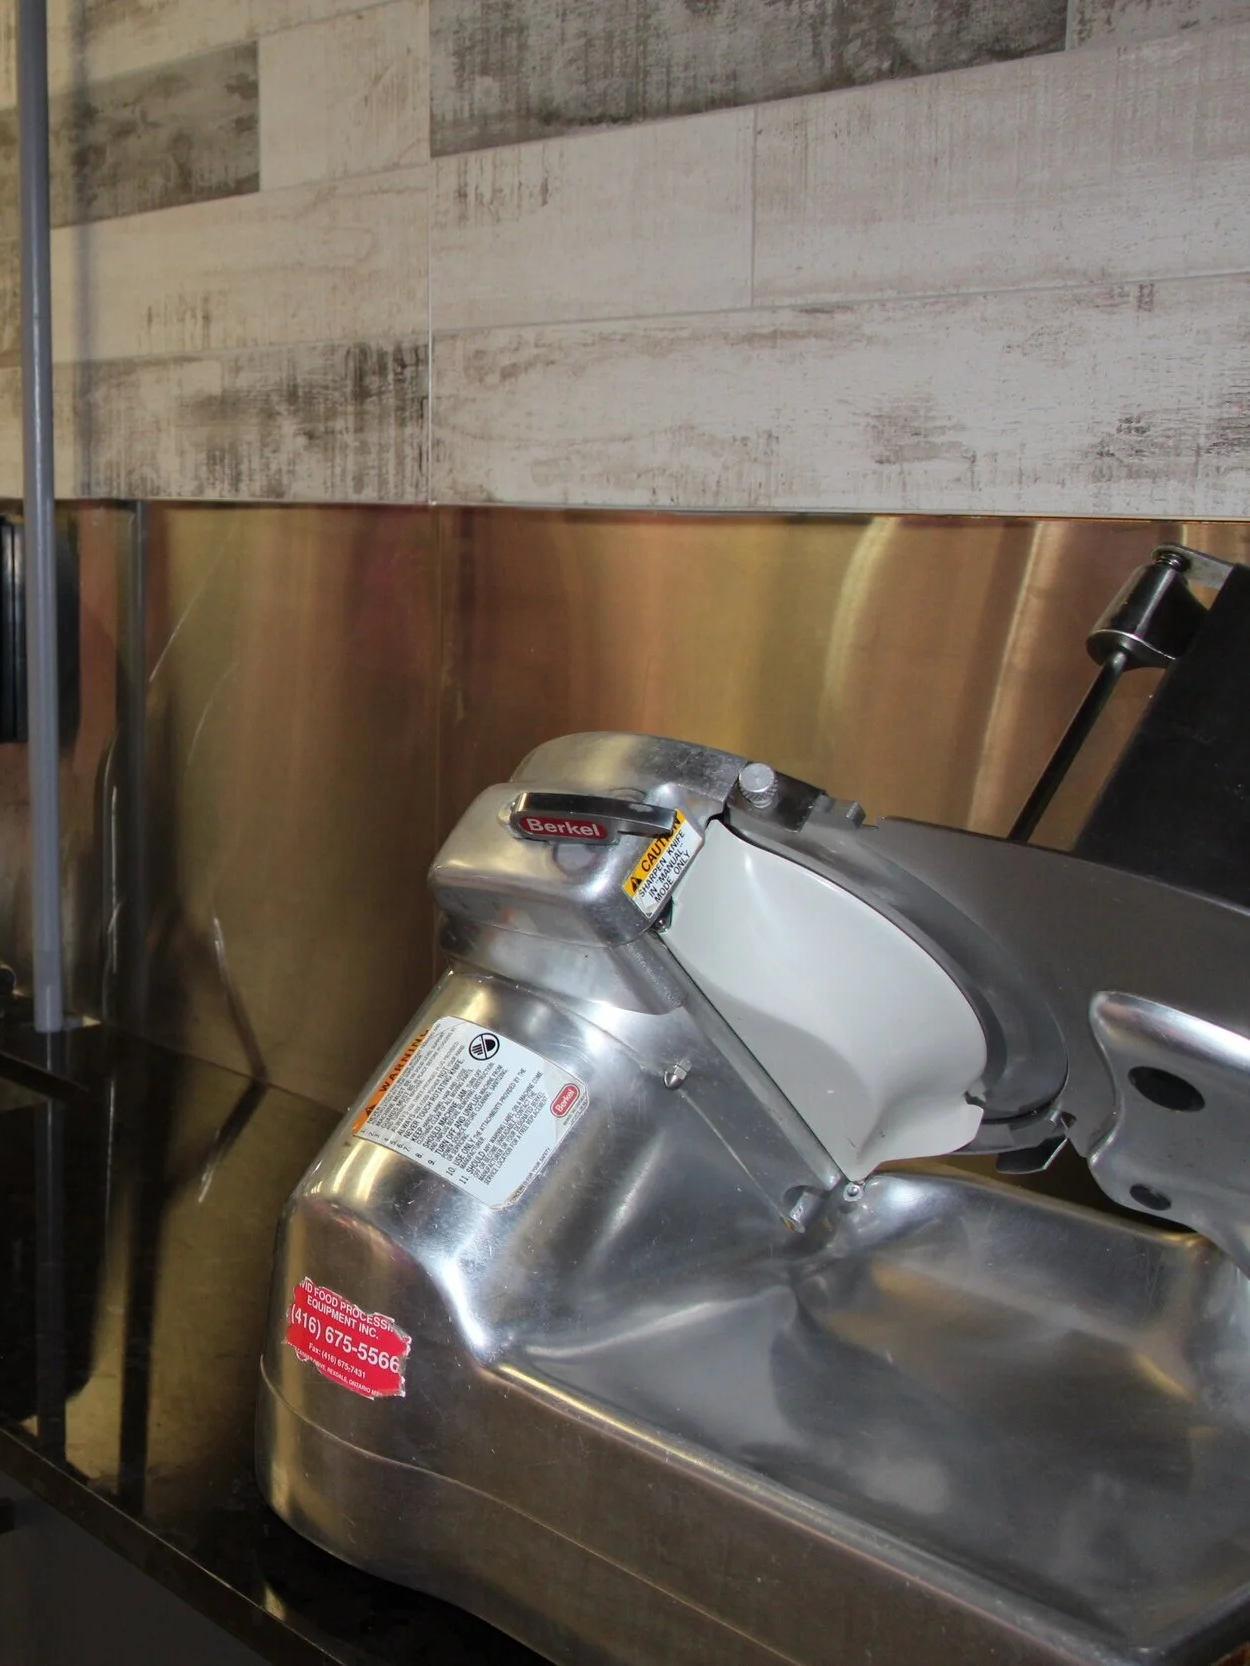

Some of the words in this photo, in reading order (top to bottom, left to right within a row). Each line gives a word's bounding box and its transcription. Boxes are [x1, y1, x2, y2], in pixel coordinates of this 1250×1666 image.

[525, 817, 601, 839] Berkel
[639, 815, 681, 873] CAUTN
[637, 856, 666, 898] SHARPEN
[665, 829, 685, 856] KNIFE
[653, 875, 673, 903] MODE
[672, 849, 691, 875] ONLY
[648, 885, 657, 897] IN
[511, 1075, 521, 1083] BY
[516, 1067, 527, 1076] THE
[395, 1112, 416, 1135] ALWAYS
[436, 1066, 449, 1079] NOT
[443, 1096, 453, 1105] ALL
[448, 1081, 464, 1098] MOVING
[497, 1081, 517, 1103] PROVIDED
[526, 1090, 537, 1100] THE
[554, 1088, 575, 1112] Berkel
[374, 1102, 395, 1126] MACHINE
[392, 1087, 405, 1102] MUST
[402, 1078, 411, 1087] BE
[379, 1106, 399, 1128] GUARDS
[395, 1091, 410, 1107] MUST
[406, 1082, 416, 1091] BE
[402, 1119, 420, 1139] NEVER
[415, 1100, 434, 1120] TOUCH
[428, 1074, 452, 1102] ROTATING
[409, 1125, 425, 1142] KEEP
[447, 1080, 457, 1090] AND
[453, 1067, 467, 1081] LOOSE
[420, 1125, 442, 1148] SHOULD
[436, 1100, 460, 1126] MACHINE
[465, 1076, 477, 1088] TURN
[472, 1068, 482, 1077] OFF
[433, 1138, 450, 1155] TURN
[444, 1127, 458, 1140] OFF
[452, 1114, 467, 1129] AND
[460, 1092, 483, 1116] UNPLUG
[477, 1076, 495, 1095] MACHINE
[490, 1063, 504, 1077] FROM
[439, 1103, 448, 1111] OF
[512, 1098, 532, 1119] CONTACT
[390, 1110, 409, 1132] ALWAYS
[427, 1140, 438, 1151] AND
[433, 1125, 450, 1142] UNPLUG
[445, 1109, 461, 1126] BEFORE
[456, 1088, 476, 1110] REMOVING
[429, 1110, 444, 1125] CLEAR
[457, 1173, 470, 1184] 11.
[464, 1149, 487, 1174] SHOULD
[481, 1142, 493, 1152] ANY
[487, 1123, 507, 1144] WARNING
[501, 1111, 514, 1124] LABEL
[510, 1104, 520, 1112] ON
[517, 1082, 535, 1102] MACHINE
[530, 1070, 543, 1084] COME
[476, 1100, 504, 1131] ATTACHMENTS
[415, 1123, 434, 1145] CLOTHING
[439, 1142, 455, 1158] POWER
[450, 1126, 467, 1143] SOURCE
[461, 1110, 478, 1127] BEFORE
[459, 1136, 477, 1155] ONLY
[471, 1129, 483, 1139] THE
[475, 1147, 505, 1181] MANUFACTURER
[499, 1140, 509, 1149] OR
[504, 1130, 517, 1143] YOUR
[511, 1105, 535, 1132] DESIGNATED
[529, 1090, 545, 1107] BERKEL
[446, 1153, 455, 1161] OR
[451, 1152, 465, 1166] USE
[481, 1144, 499, 1163] BECOME
[482, 1166, 500, 1185] SERVICE
[493, 1145, 515, 1168] LOCATION
[508, 1137, 519, 1148] FOR
[516, 1123, 530, 1135] FREE
[444, 1164, 457, 1176] 10.
[471, 1167, 482, 1177] OFF
[477, 1161, 487, 1170] OR
[299, 1280, 312, 1294] VID
[314, 1286, 338, 1308] FOOD
[340, 1301, 394, 1333] PROCESSI
[307, 1295, 358, 1329] EQUIPMENT
[359, 1323, 379, 1340] INC.
[291, 1303, 321, 1340] (416)
[325, 1327, 400, 1374] 675-5566
[309, 1342, 321, 1355] Fax:
[321, 1351, 337, 1366] (416)
[337, 1359, 366, 1379] 675-7431
